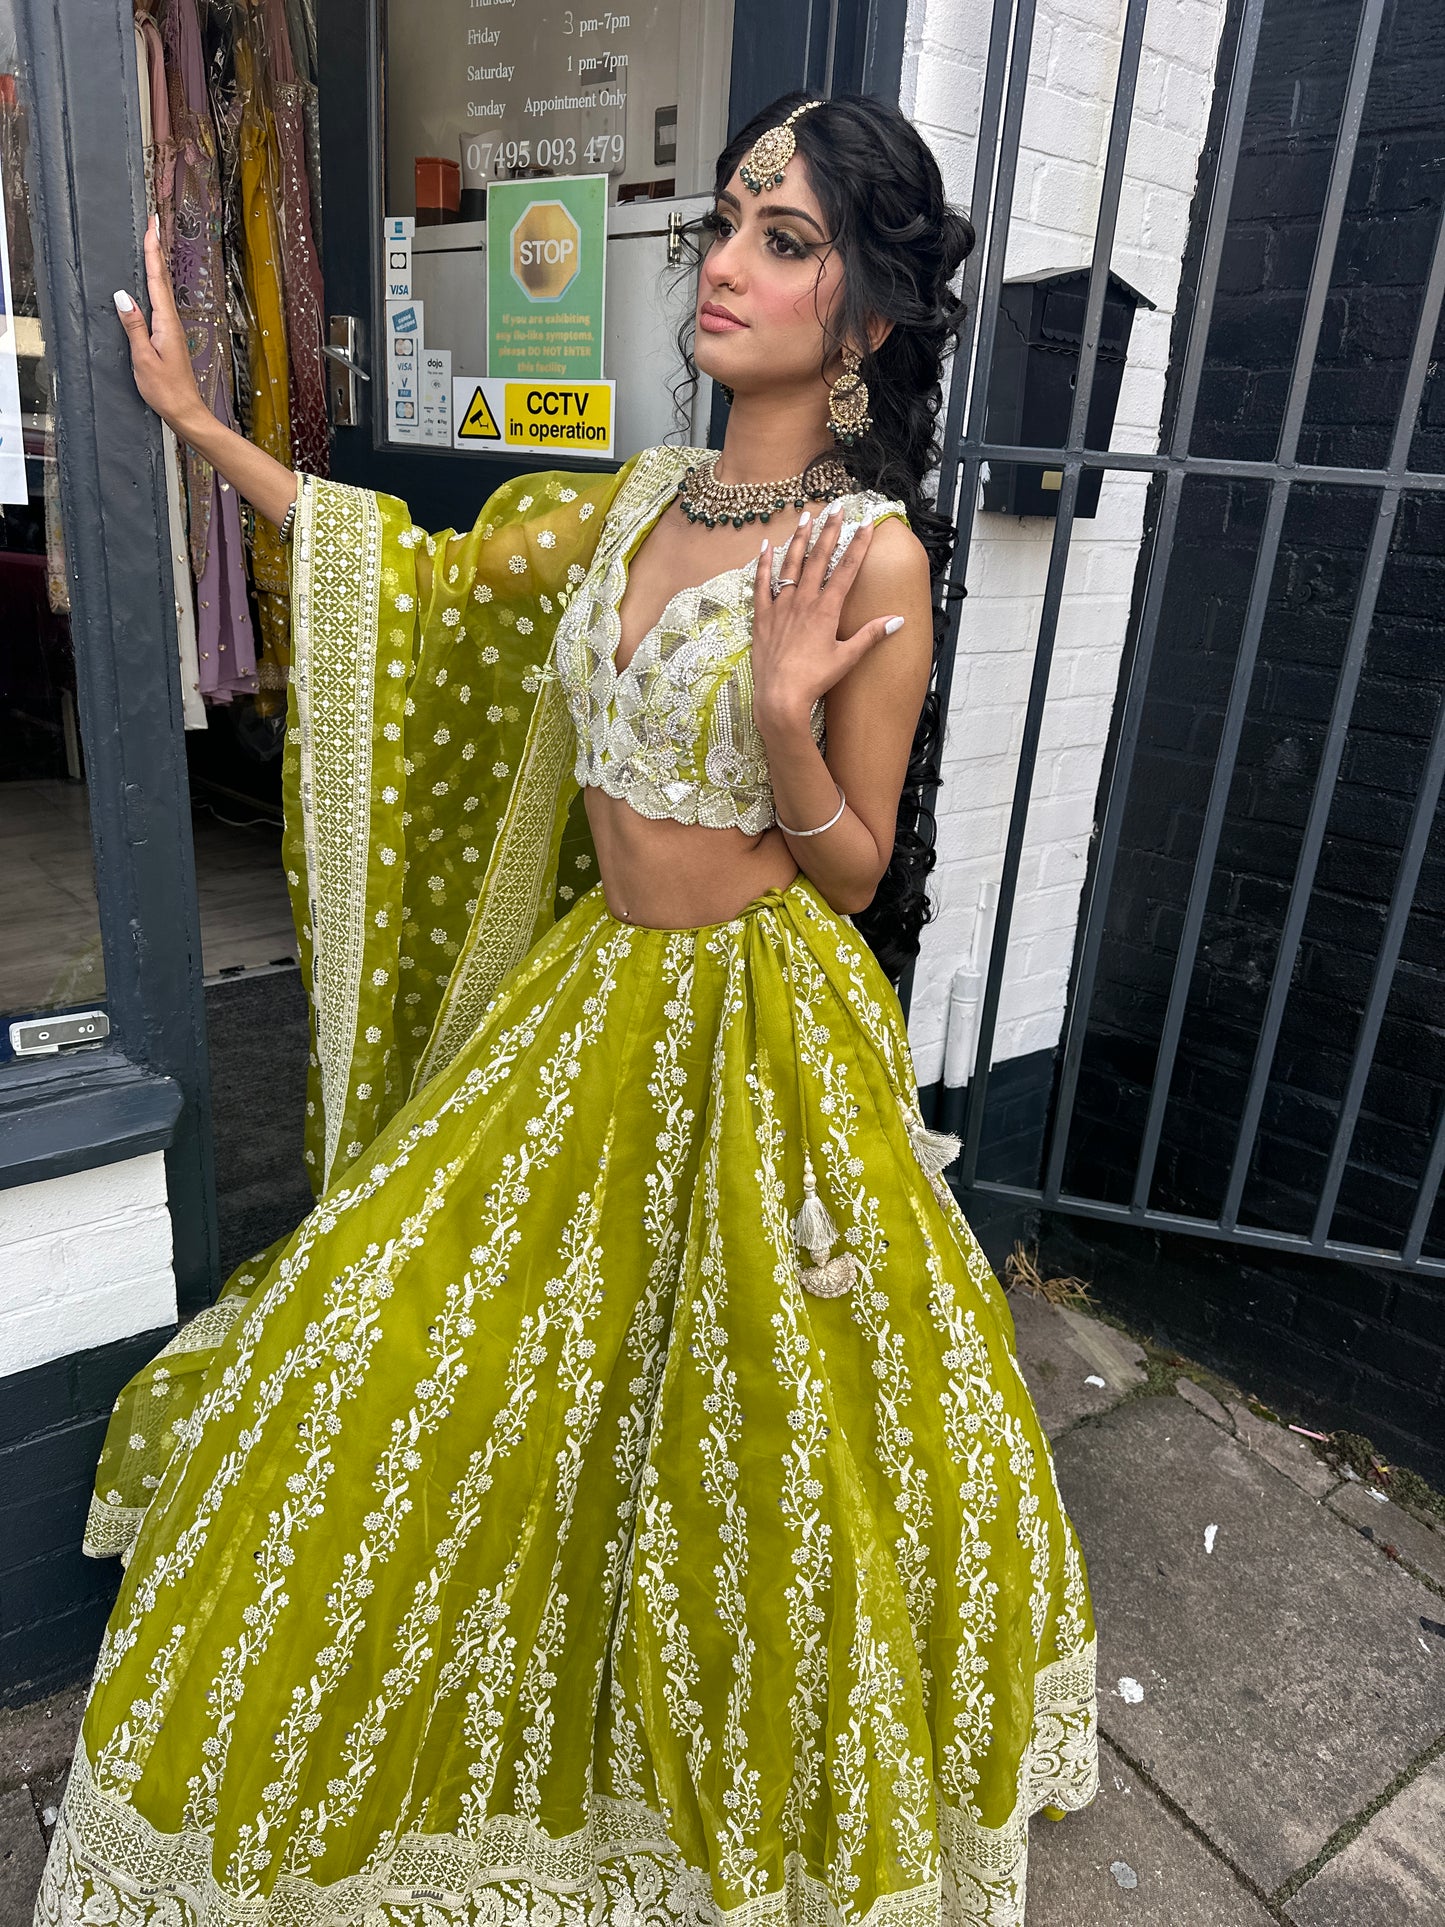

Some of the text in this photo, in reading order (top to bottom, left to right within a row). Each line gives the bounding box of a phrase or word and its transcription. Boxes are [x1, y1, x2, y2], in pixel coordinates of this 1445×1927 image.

[467, 10, 630, 47] Friday 3 pm-7pm
[467, 51, 629, 82] Saturday 1 pm-7pm
[467, 89, 627, 119] Sunday Appointment Only
[466, 134, 625, 171] 07495 093 479
[520, 239, 574, 265] STOP
[389, 284, 409, 295] VISA
[511, 315, 527, 327] you
[528, 315, 543, 324] are
[545, 312, 591, 326] exhibiting
[495, 331, 512, 343] any
[513, 329, 544, 341] flu-like
[498, 345, 592, 357] please DO NOT ENTER
[397, 362, 412, 371] VISA
[517, 361, 567, 375] this facility
[526, 390, 589, 416] CCTV
[509, 418, 606, 442] in operation
